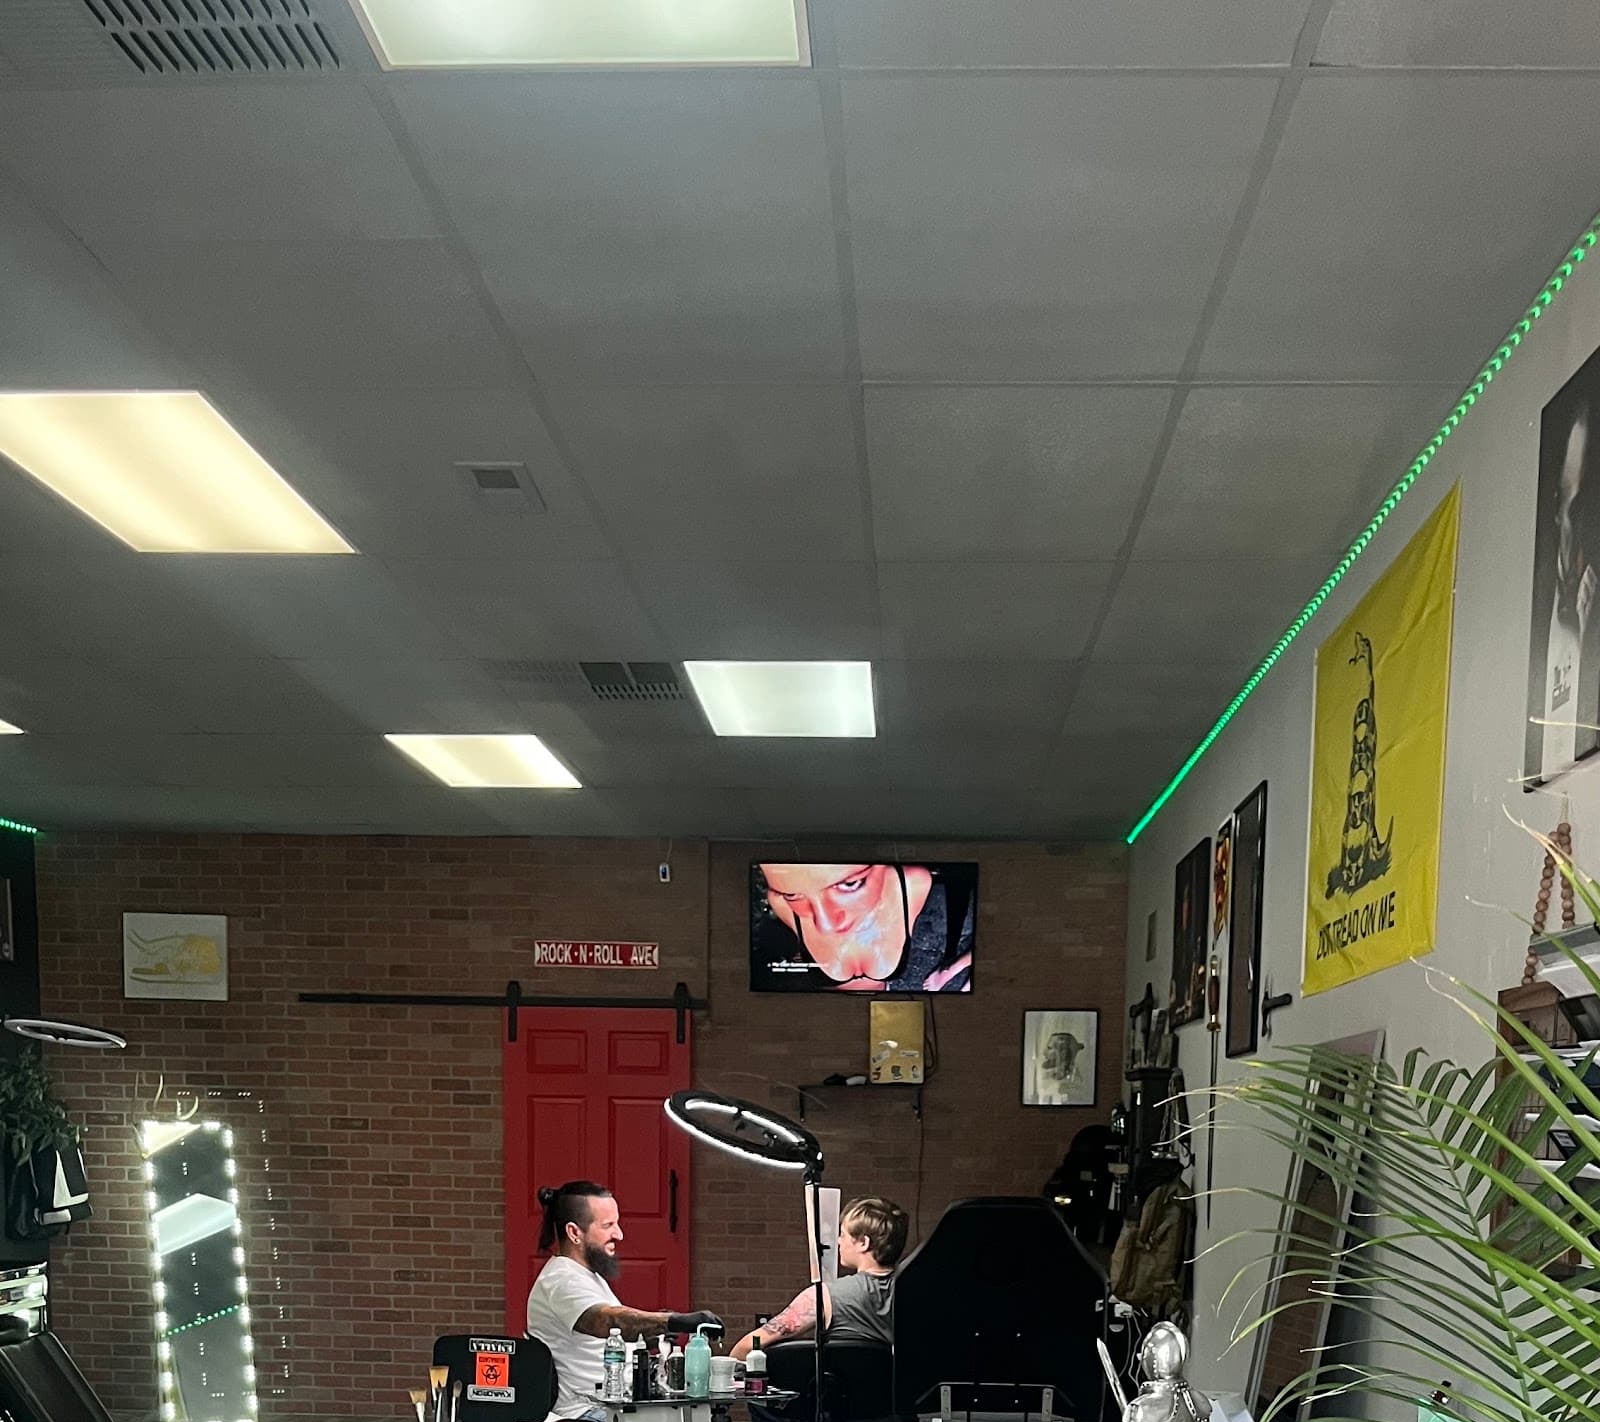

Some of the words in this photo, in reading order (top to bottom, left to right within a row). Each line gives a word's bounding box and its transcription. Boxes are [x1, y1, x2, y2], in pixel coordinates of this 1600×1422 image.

[1361, 901, 1378, 938] ON
[1379, 891, 1395, 932] ME
[630, 945, 653, 965] AVE
